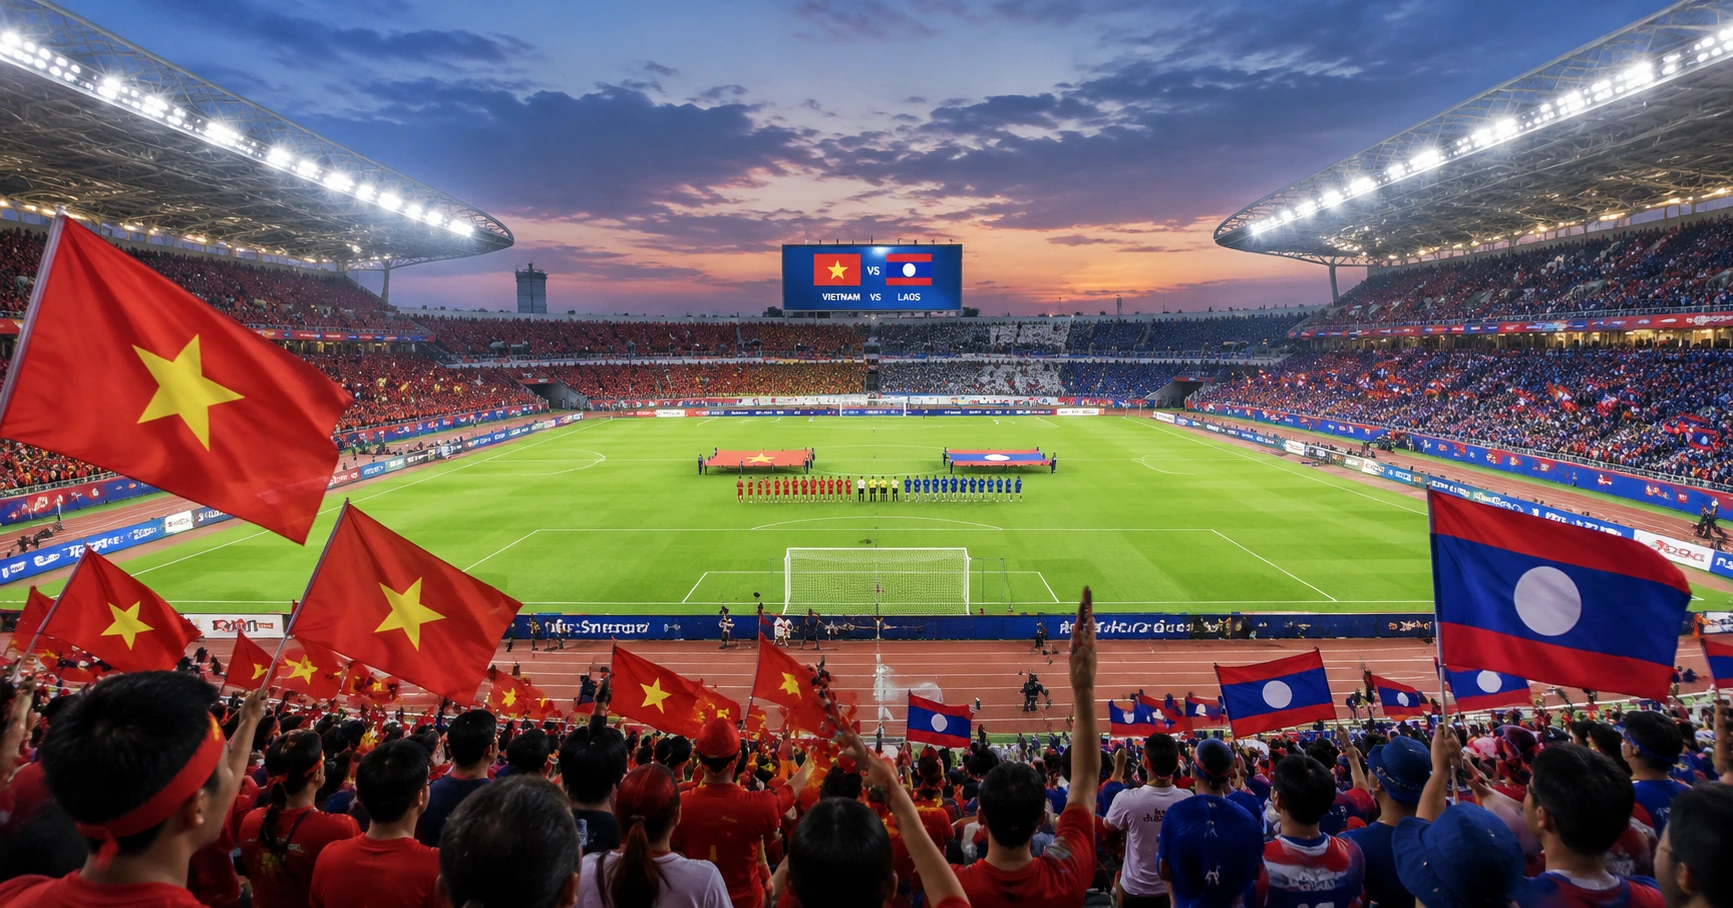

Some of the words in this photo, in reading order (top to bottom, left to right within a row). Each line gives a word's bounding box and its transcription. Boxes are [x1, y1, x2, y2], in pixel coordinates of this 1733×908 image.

[866, 266, 880, 276] VS
[821, 293, 861, 301] VIETNAM
[869, 293, 882, 301] VS
[897, 293, 921, 301] LAOS
